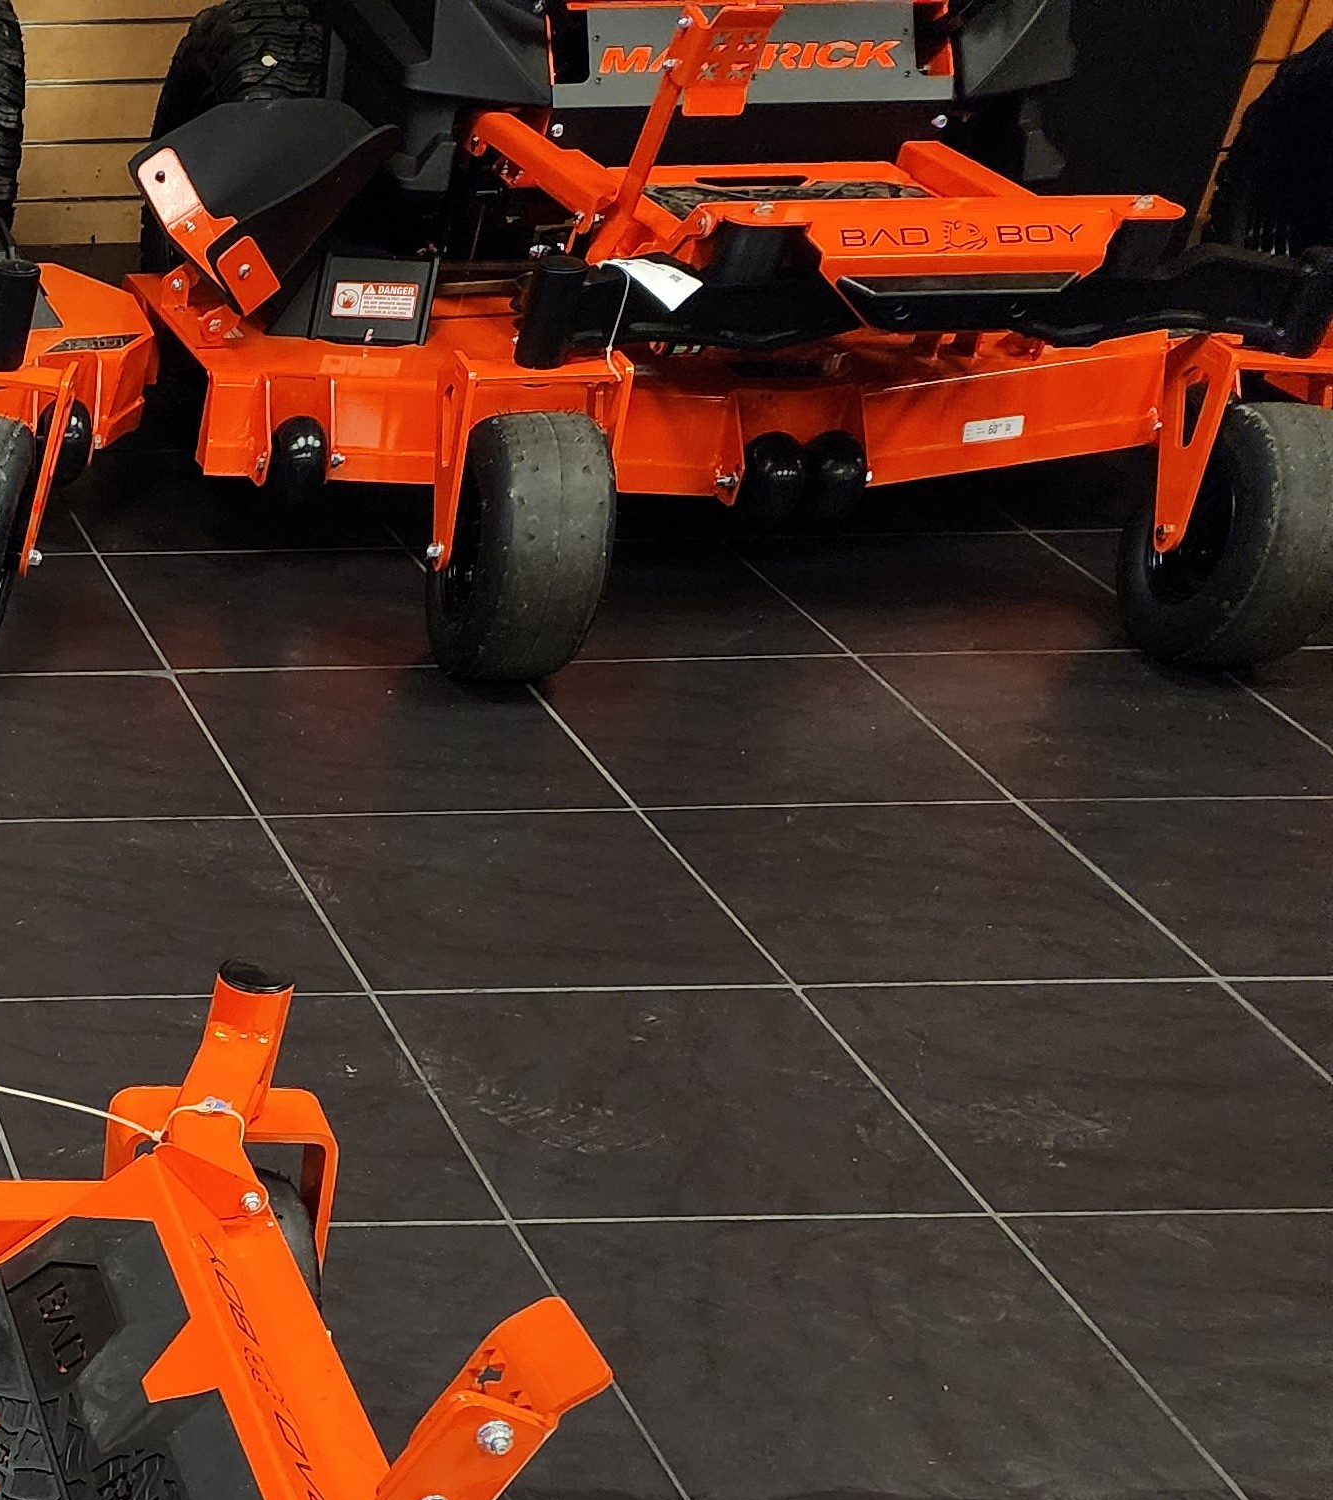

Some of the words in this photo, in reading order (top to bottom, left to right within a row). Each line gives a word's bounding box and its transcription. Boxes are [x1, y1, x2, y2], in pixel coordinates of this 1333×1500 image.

[599, 40, 902, 74] MRICK
[840, 227, 930, 247] BAD
[996, 224, 1083, 244] BOY
[378, 285, 414, 295] DANGER
